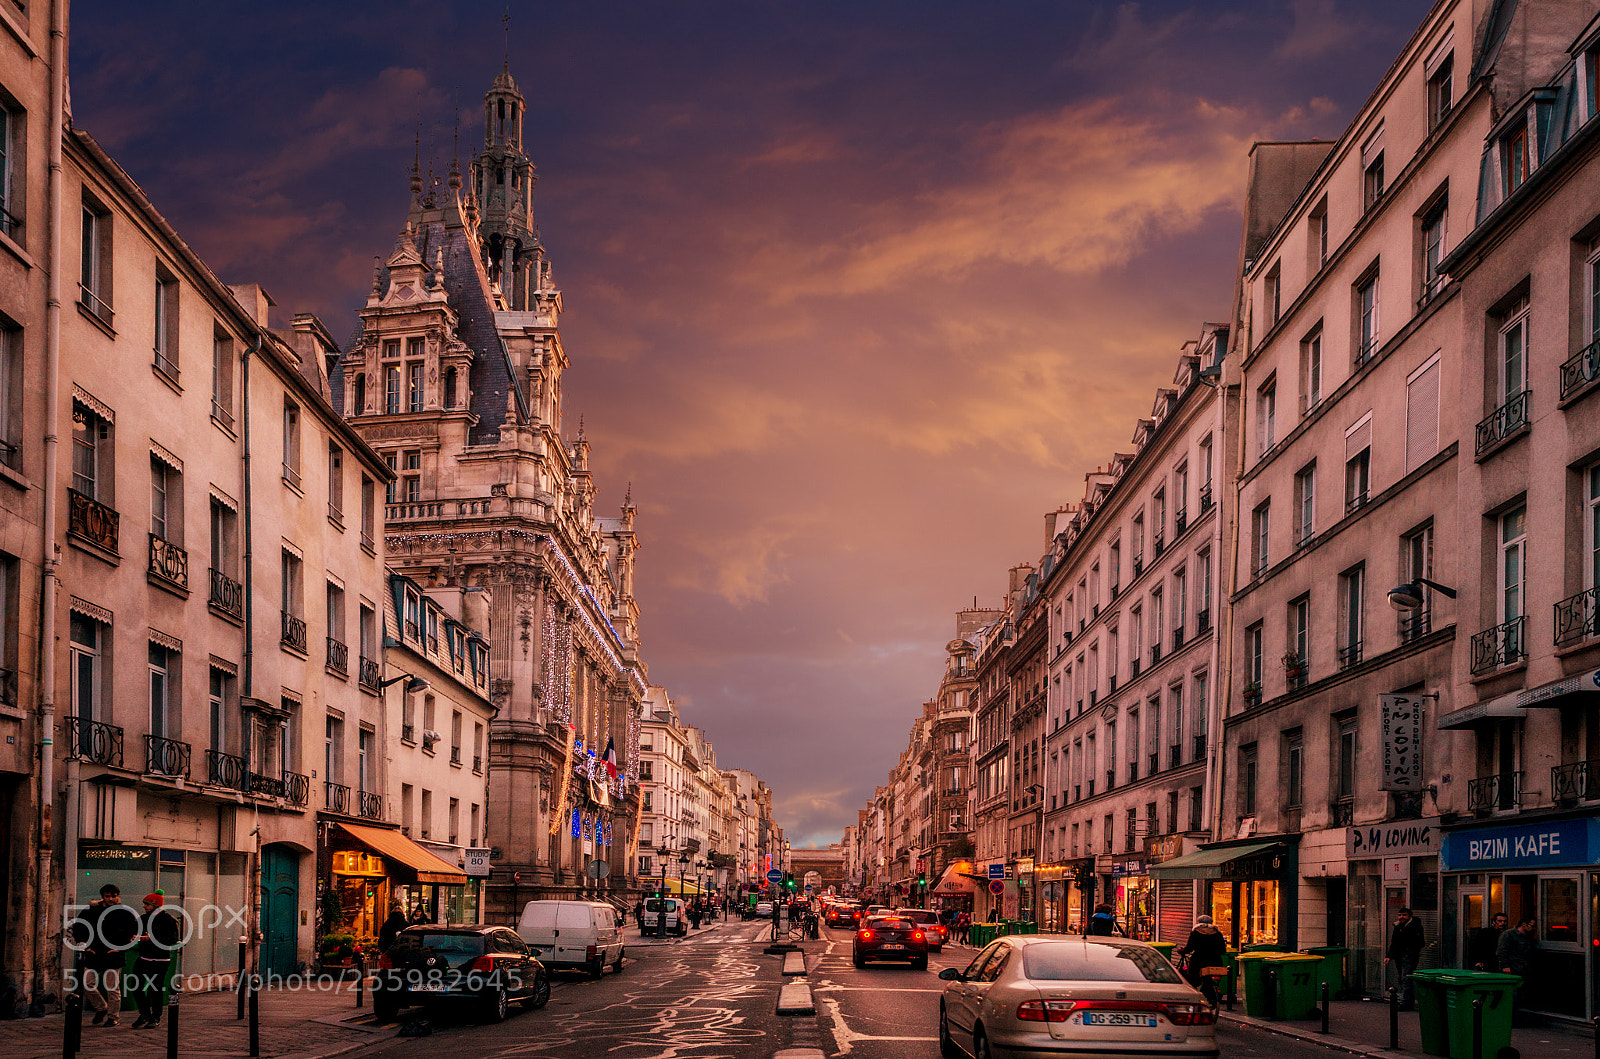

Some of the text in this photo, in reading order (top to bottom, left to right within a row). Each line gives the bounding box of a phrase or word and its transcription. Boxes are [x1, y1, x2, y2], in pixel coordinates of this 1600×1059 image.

[1383, 702, 1391, 735] IMPORT
[1394, 726, 1410, 785] LOVING
[1353, 826, 1431, 853] P.M LOVING
[1469, 832, 1560, 861] BIZIM KAFE
[1292, 973, 1310, 985] 77
[1090, 1013, 1149, 1025] DG-259-TT
